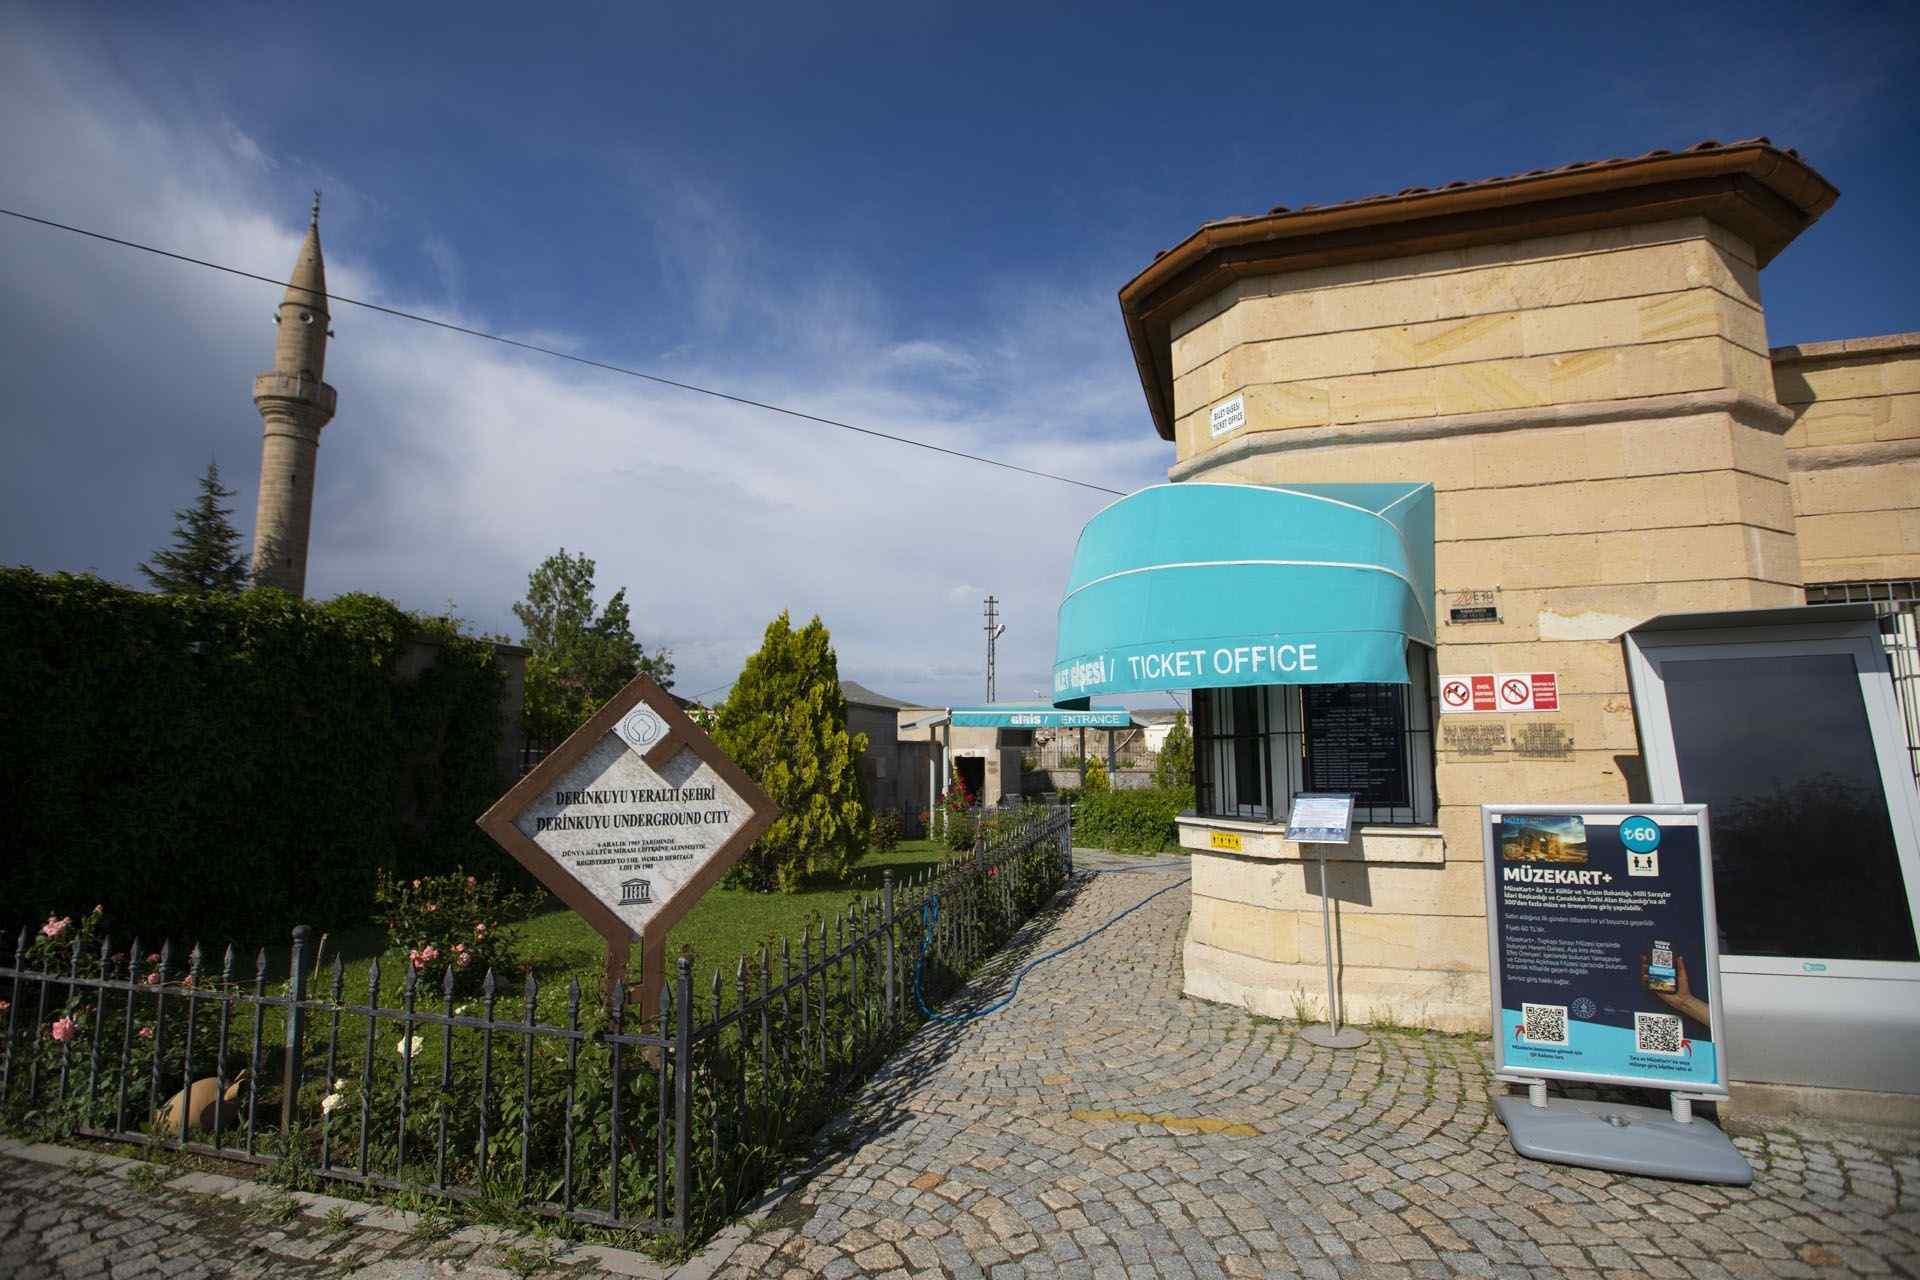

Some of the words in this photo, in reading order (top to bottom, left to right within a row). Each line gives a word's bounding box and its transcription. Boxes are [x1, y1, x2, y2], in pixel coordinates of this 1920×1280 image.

[1128, 650, 1207, 680] TICKET
[1213, 644, 1318, 674] OFFICE
[1063, 713, 1120, 725] ENTRANCE
[556, 788, 628, 806] DERİNKUYU
[630, 789, 680, 802] YERALTI
[681, 785, 716, 804] ŞEHRİ
[536, 813, 611, 831] DERİNKUYU
[613, 811, 701, 828] UNDERGROUND
[703, 810, 731, 825] CITY
[1504, 865, 1612, 885] MÜZEKART+
